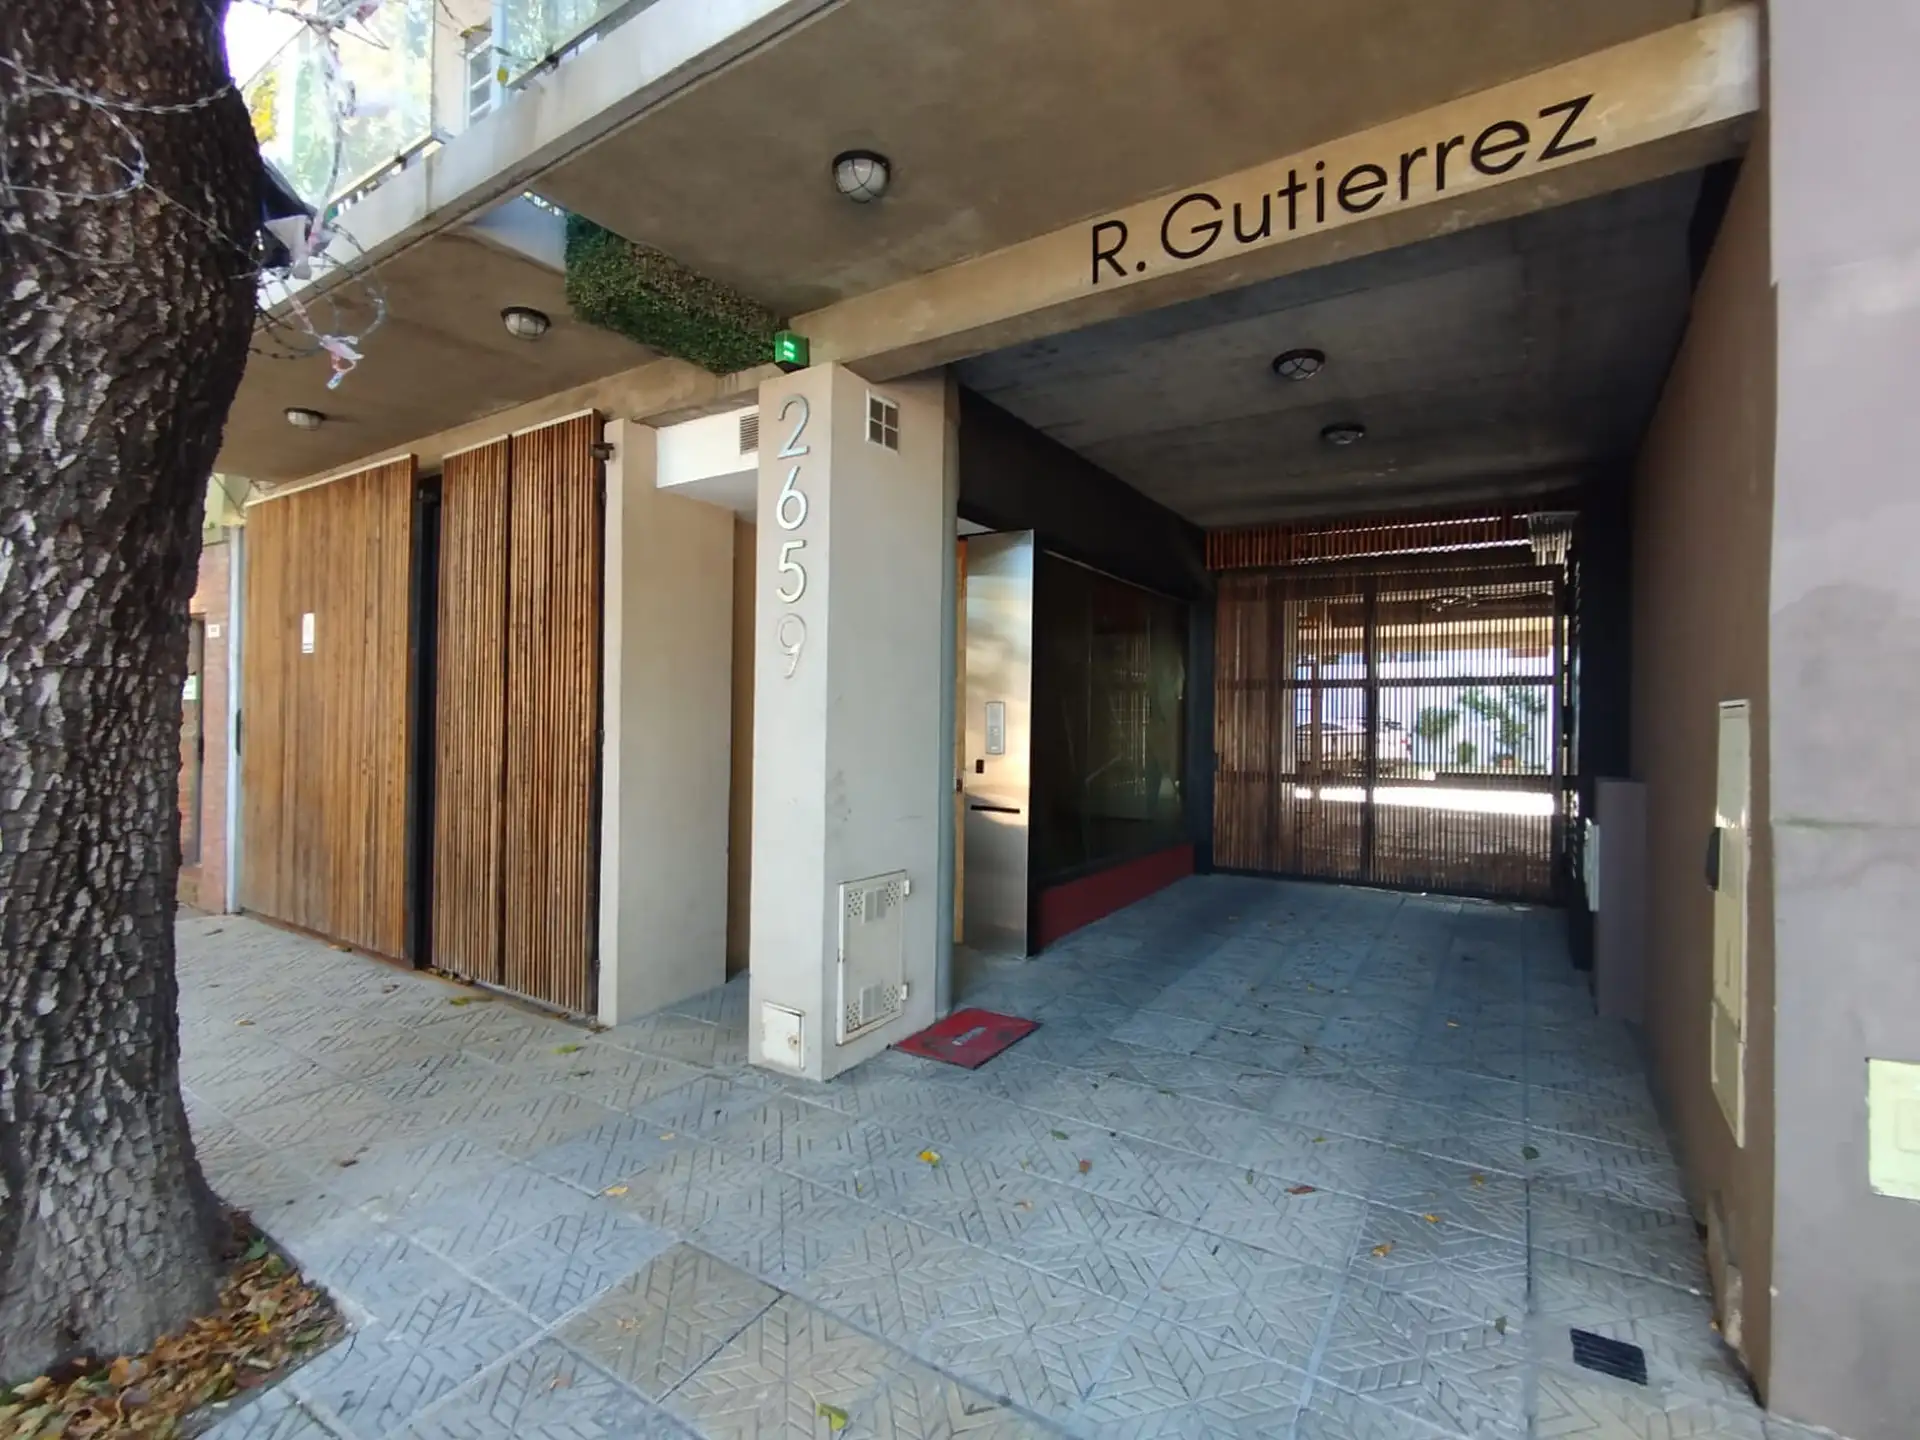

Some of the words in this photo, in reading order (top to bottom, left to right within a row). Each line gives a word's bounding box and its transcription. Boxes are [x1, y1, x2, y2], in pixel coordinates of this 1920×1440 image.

[1091, 219, 1147, 284] R.
[1160, 94, 1598, 260] Gutierrez
[776, 393, 810, 680] 2659
